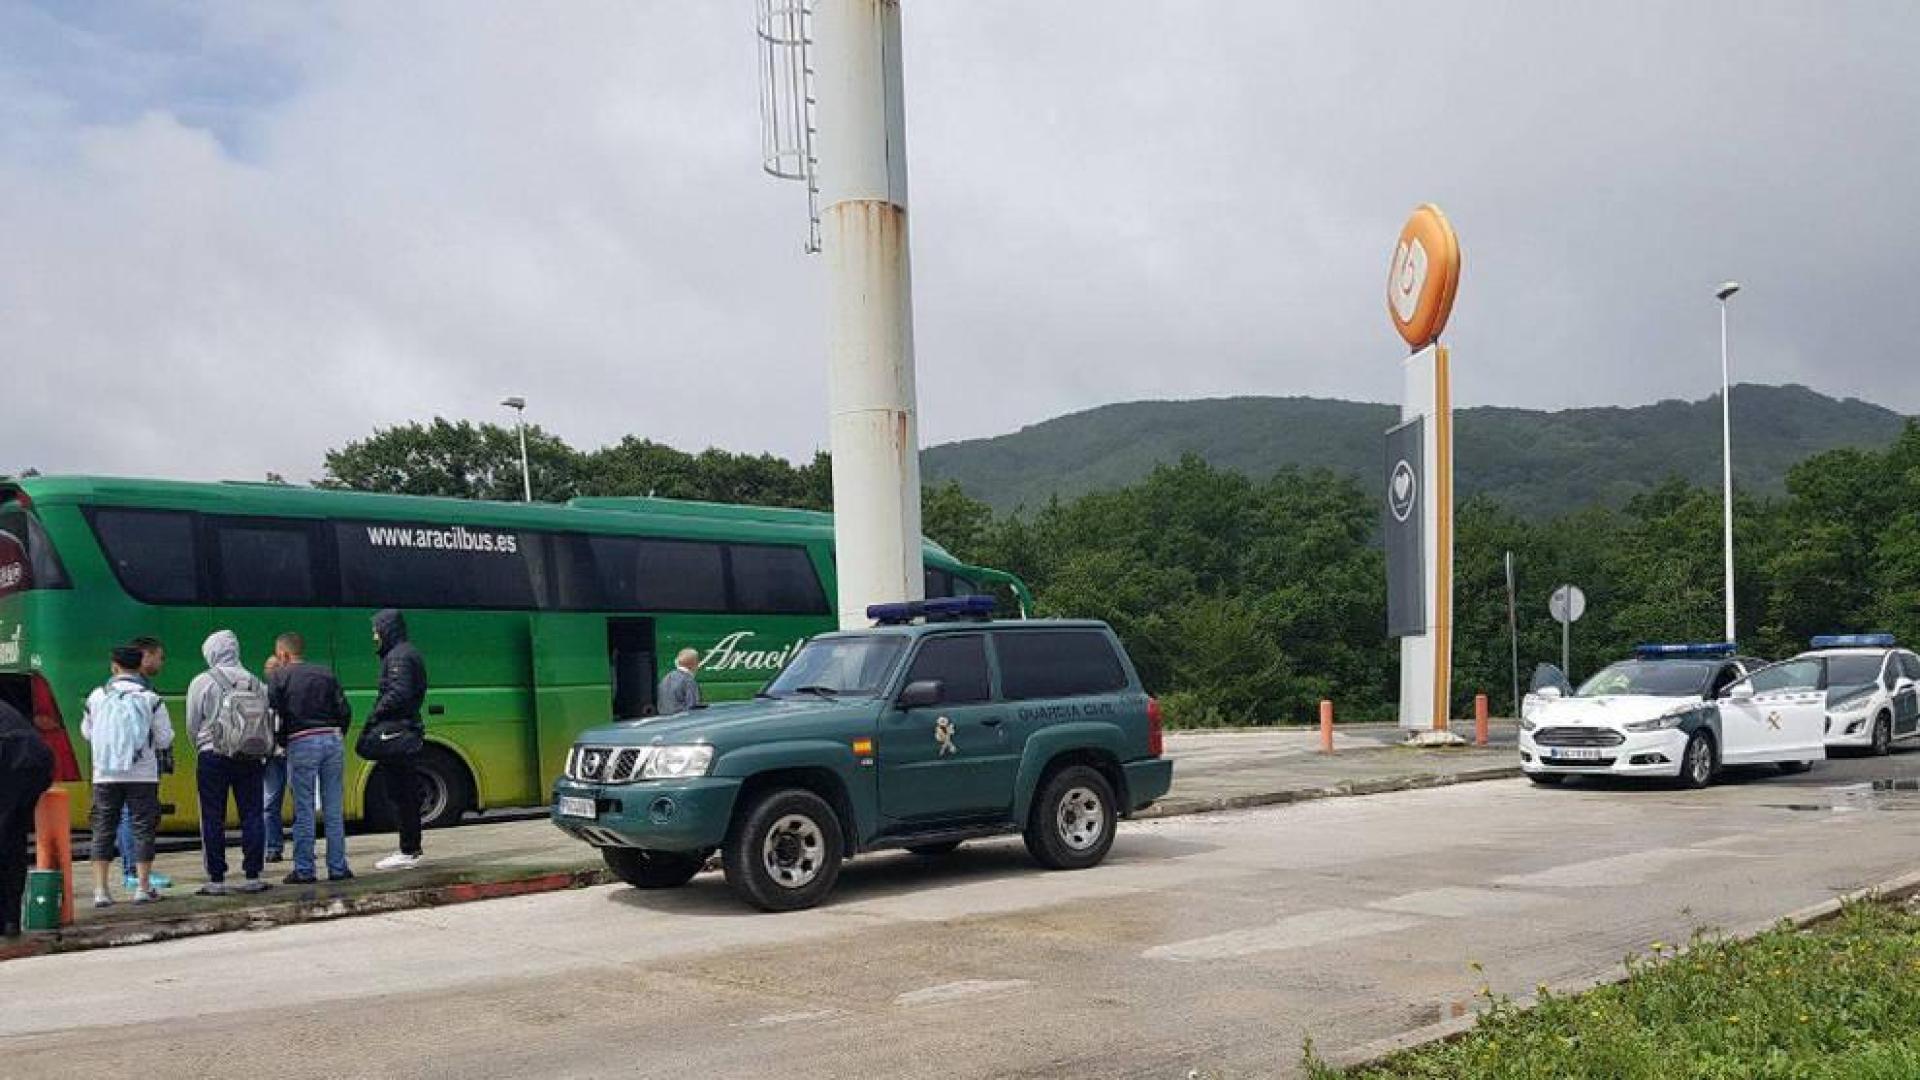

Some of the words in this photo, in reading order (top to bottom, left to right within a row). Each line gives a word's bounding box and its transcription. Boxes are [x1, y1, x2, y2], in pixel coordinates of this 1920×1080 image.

[366, 526, 517, 553] www.aracilbus.es
[697, 631, 805, 671] Aracil
[1018, 704, 1081, 719] GUARDIA
[1083, 703, 1116, 716] CIVIL
